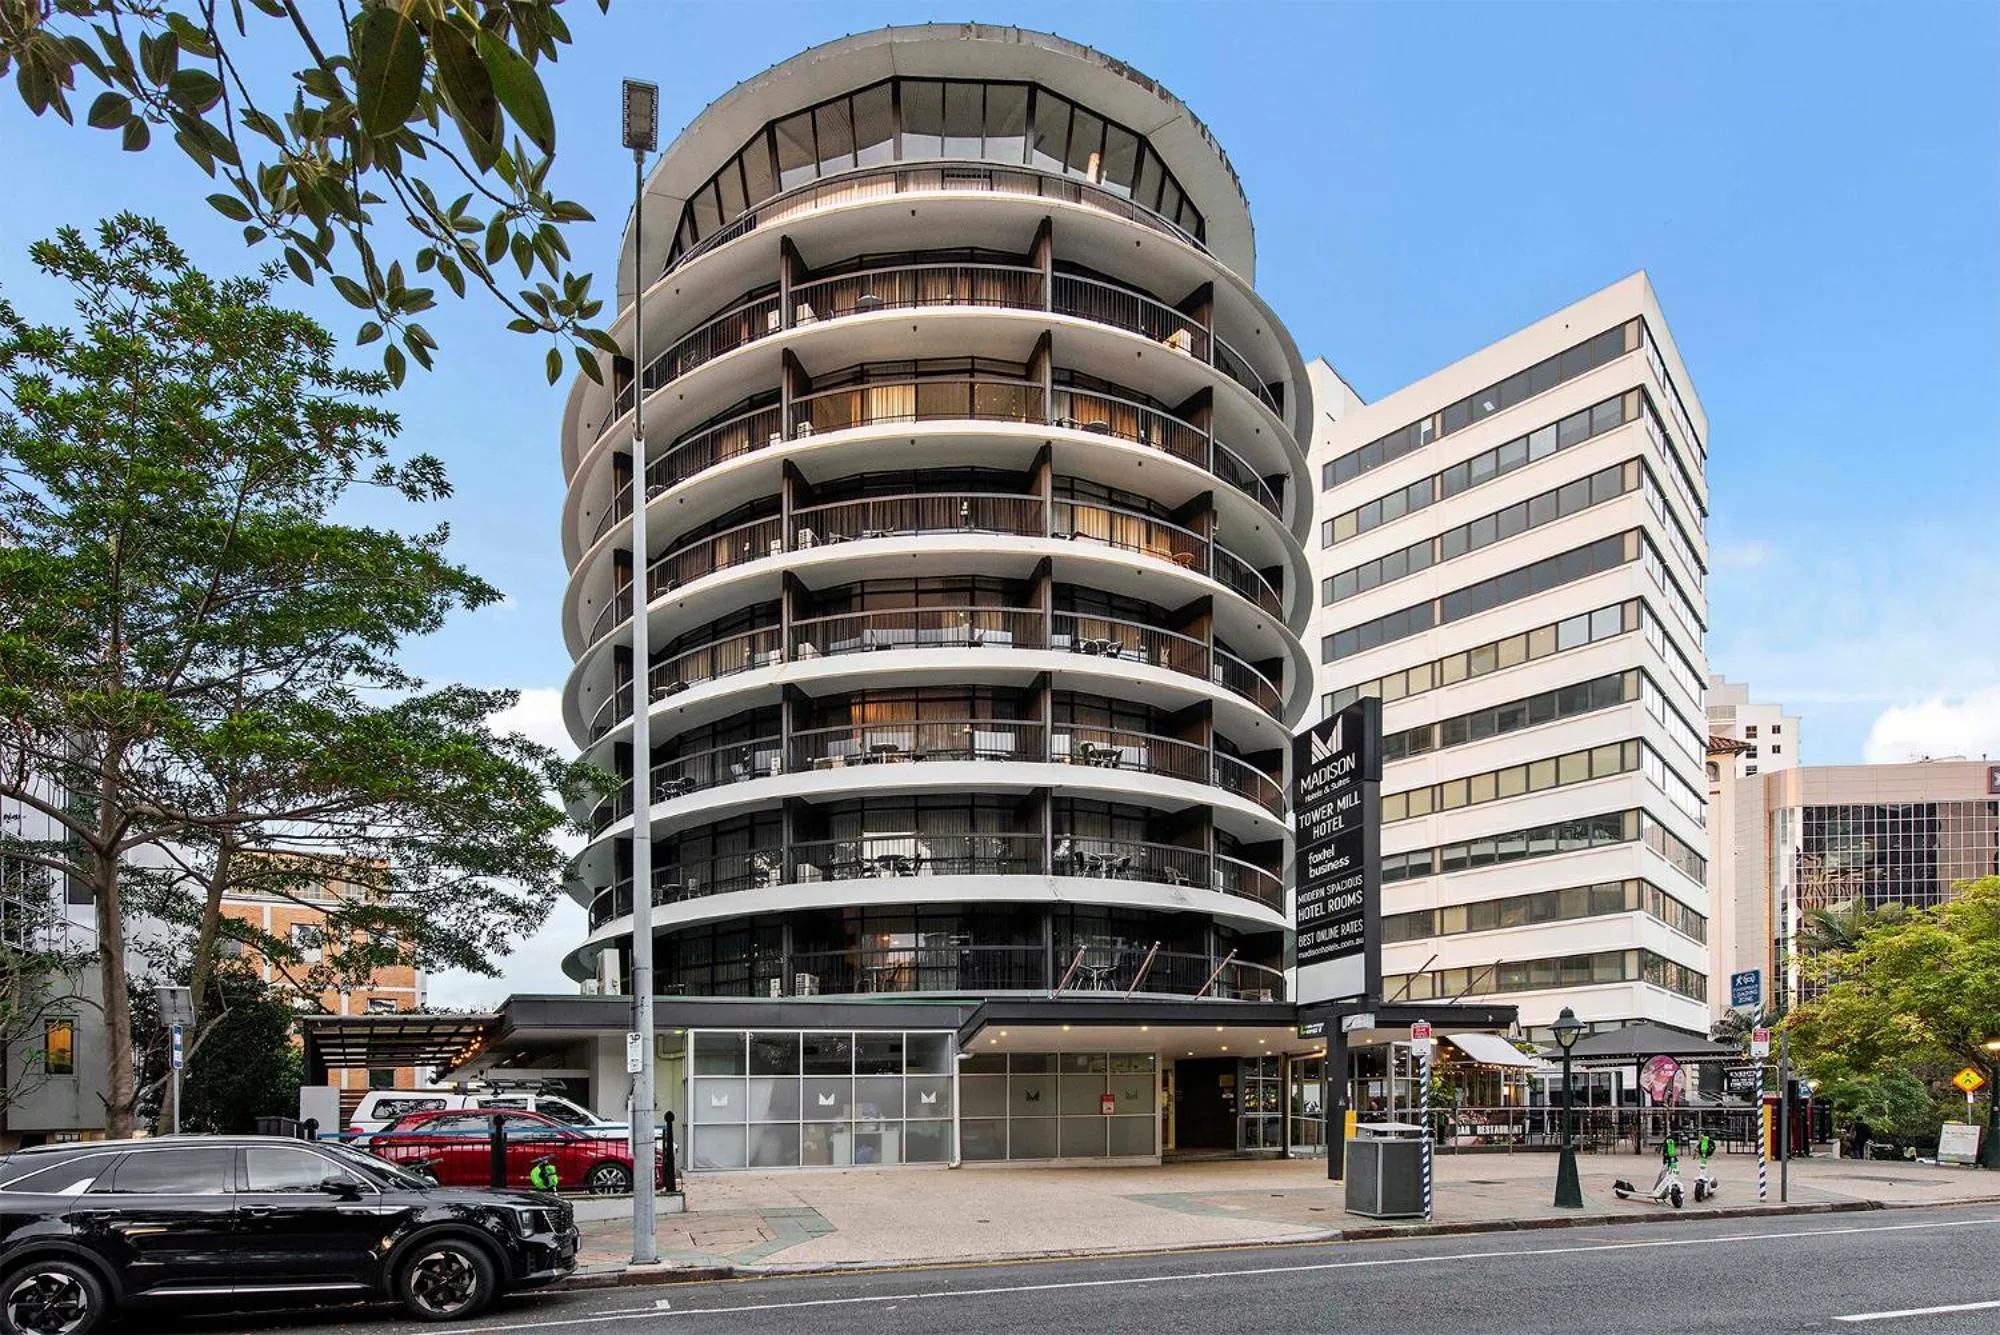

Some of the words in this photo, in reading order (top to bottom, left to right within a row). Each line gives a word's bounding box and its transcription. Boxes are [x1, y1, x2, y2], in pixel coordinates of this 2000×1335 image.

[1300, 751, 1356, 794] MADISON
[1324, 785, 1330, 794] &
[1298, 802, 1334, 829] TOWER
[1336, 790, 1361, 813] MILL
[1312, 815, 1345, 840] HOTEL
[1308, 843, 1335, 865] foxtel
[1308, 855, 1350, 879] business
[1298, 887, 1325, 905] MODERN
[1326, 874, 1363, 896] SPACIOUS
[1298, 902, 1326, 922] HOTEL
[1327, 890, 1363, 913] ROOMS
[1298, 931, 1315, 948] BEST
[1316, 924, 1340, 943] ONLINE
[1340, 918, 1364, 936] RATES
